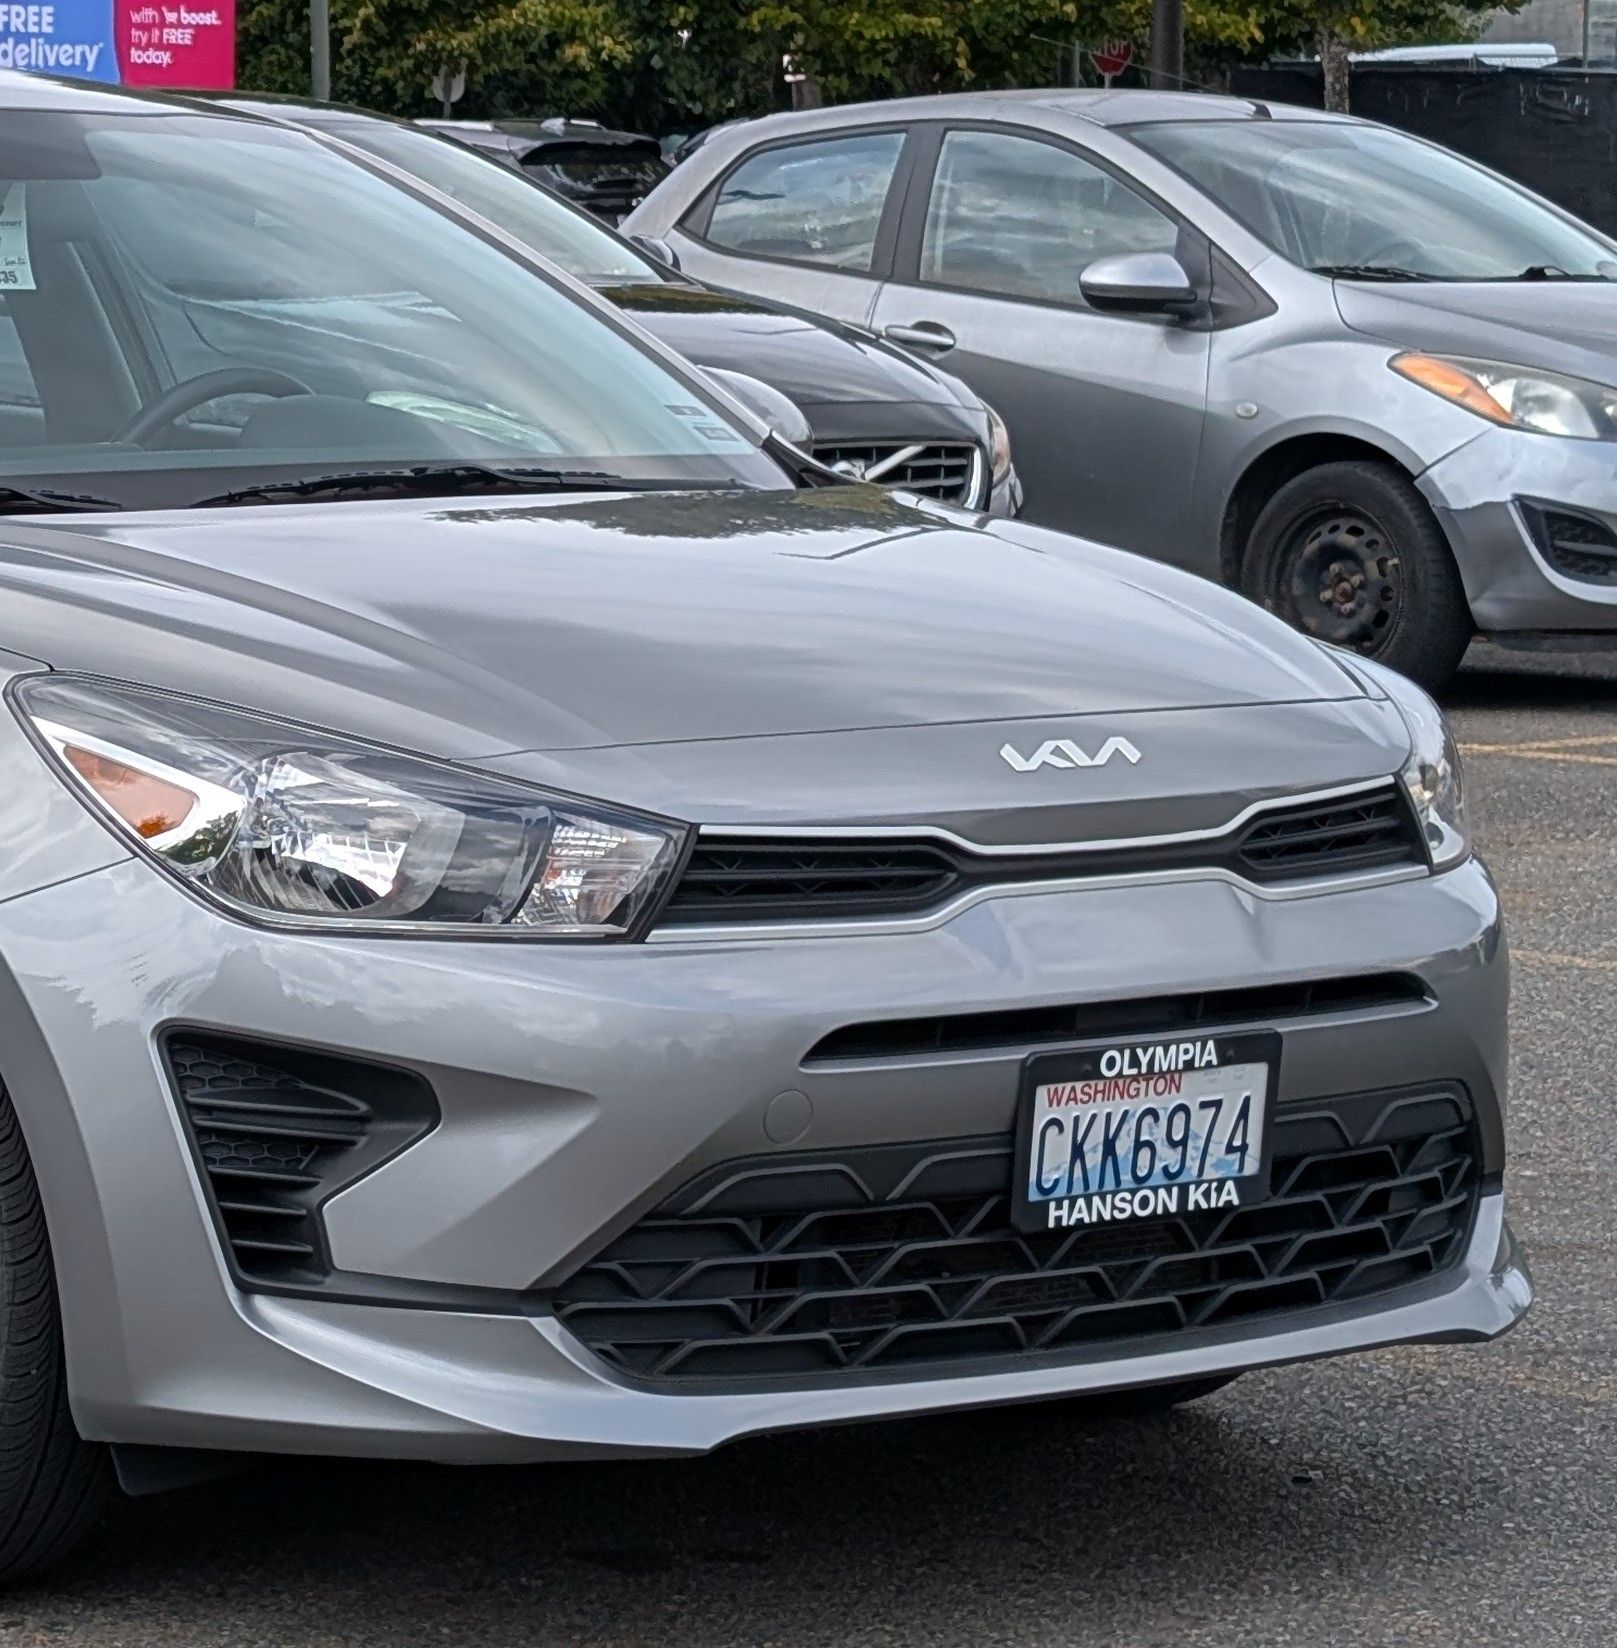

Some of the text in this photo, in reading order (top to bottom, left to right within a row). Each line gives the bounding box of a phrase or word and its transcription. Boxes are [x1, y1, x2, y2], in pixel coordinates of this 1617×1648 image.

[129, 7, 159, 24] with
[131, 27, 148, 47] try
[151, 28, 160, 43] it
[1000, 736, 1142, 771] KIA
[1100, 1039, 1218, 1077] OLYMPIA
[1046, 1072, 1183, 1108] WASHINGTON
[1034, 1094, 1251, 1196] CKK6974
[1048, 1180, 1240, 1229] HANSON KIA
